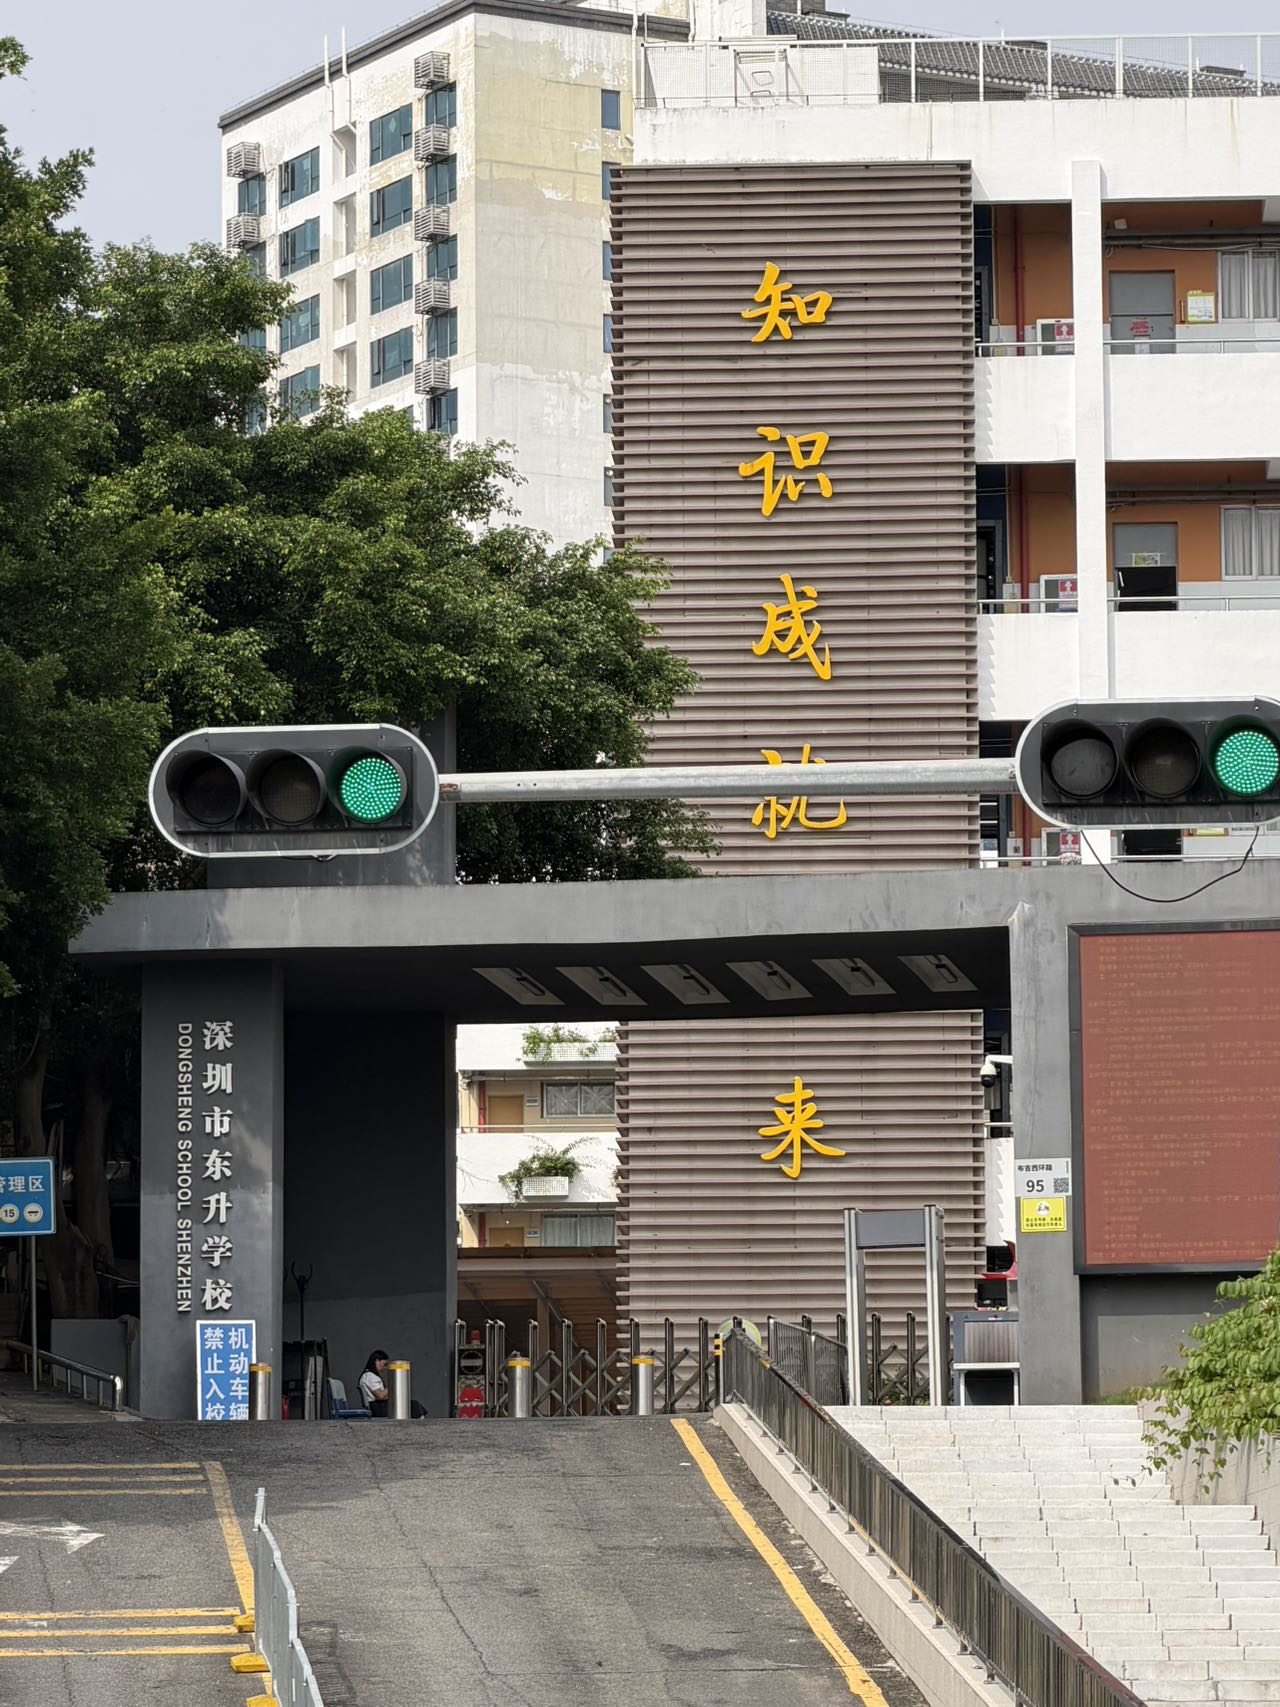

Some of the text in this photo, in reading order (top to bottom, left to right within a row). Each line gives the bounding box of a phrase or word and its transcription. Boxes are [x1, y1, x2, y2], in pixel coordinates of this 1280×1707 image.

[177, 1023, 193, 1312] DONGSHENG SCHOOL SHENZHEN
[201, 1021, 233, 1310] 深圳市东升学校
[1017, 1164, 1053, 1172] 布吉西环路
[1026, 1179, 1045, 1193] 95
[4, 1209, 15, 1218] 15
[204, 1327, 226, 1420] 禁止入校
[228, 1327, 249, 1420] 机动车辆
